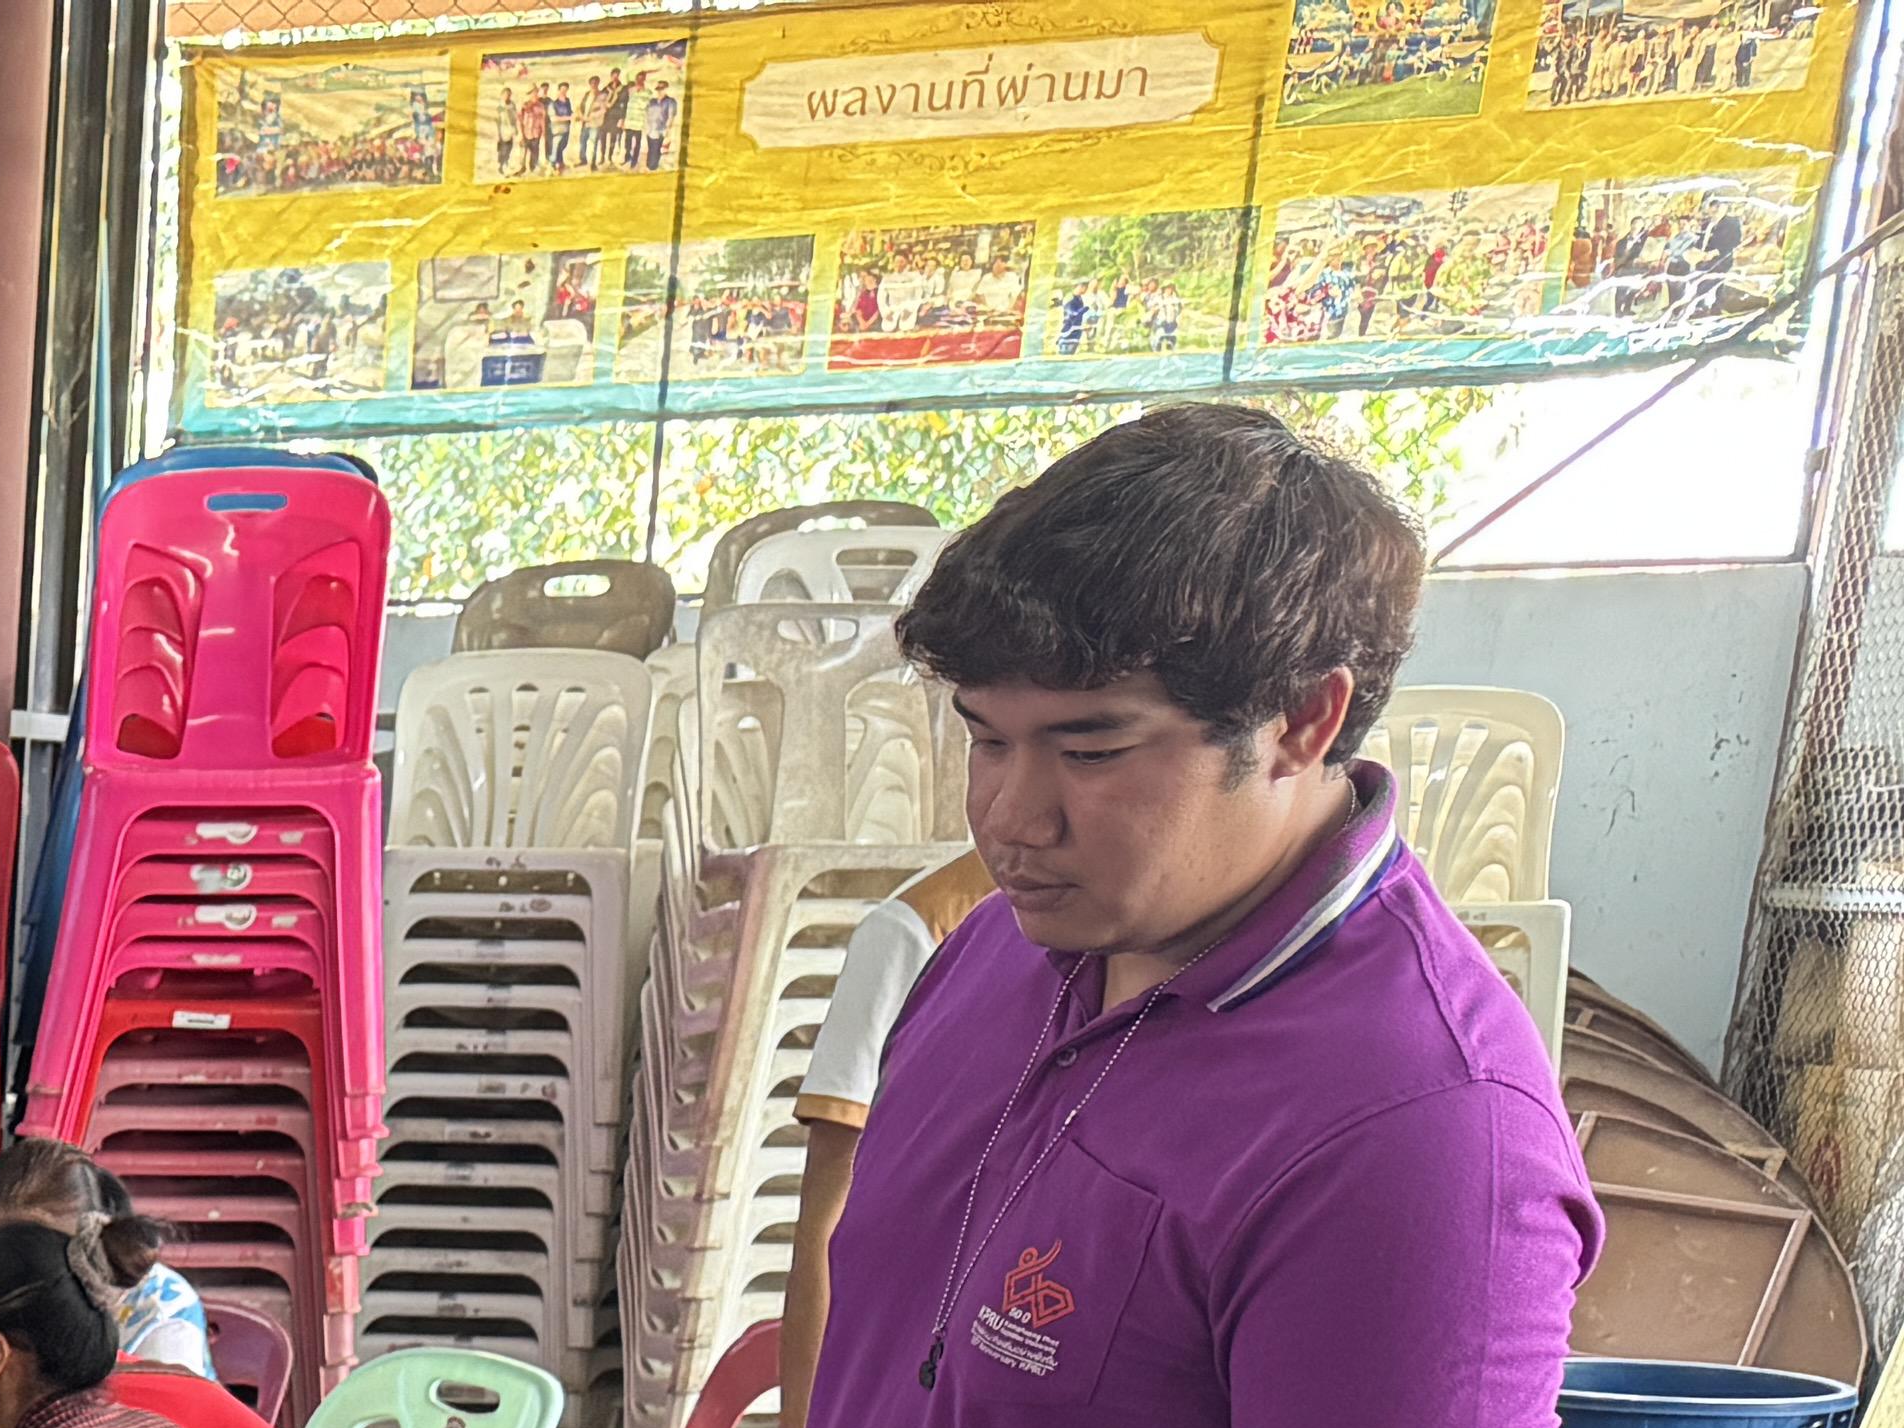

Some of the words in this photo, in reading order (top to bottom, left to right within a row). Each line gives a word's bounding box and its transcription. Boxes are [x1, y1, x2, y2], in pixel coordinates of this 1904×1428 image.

[806, 53, 1149, 122] ผลงานที่ผ่านมา
